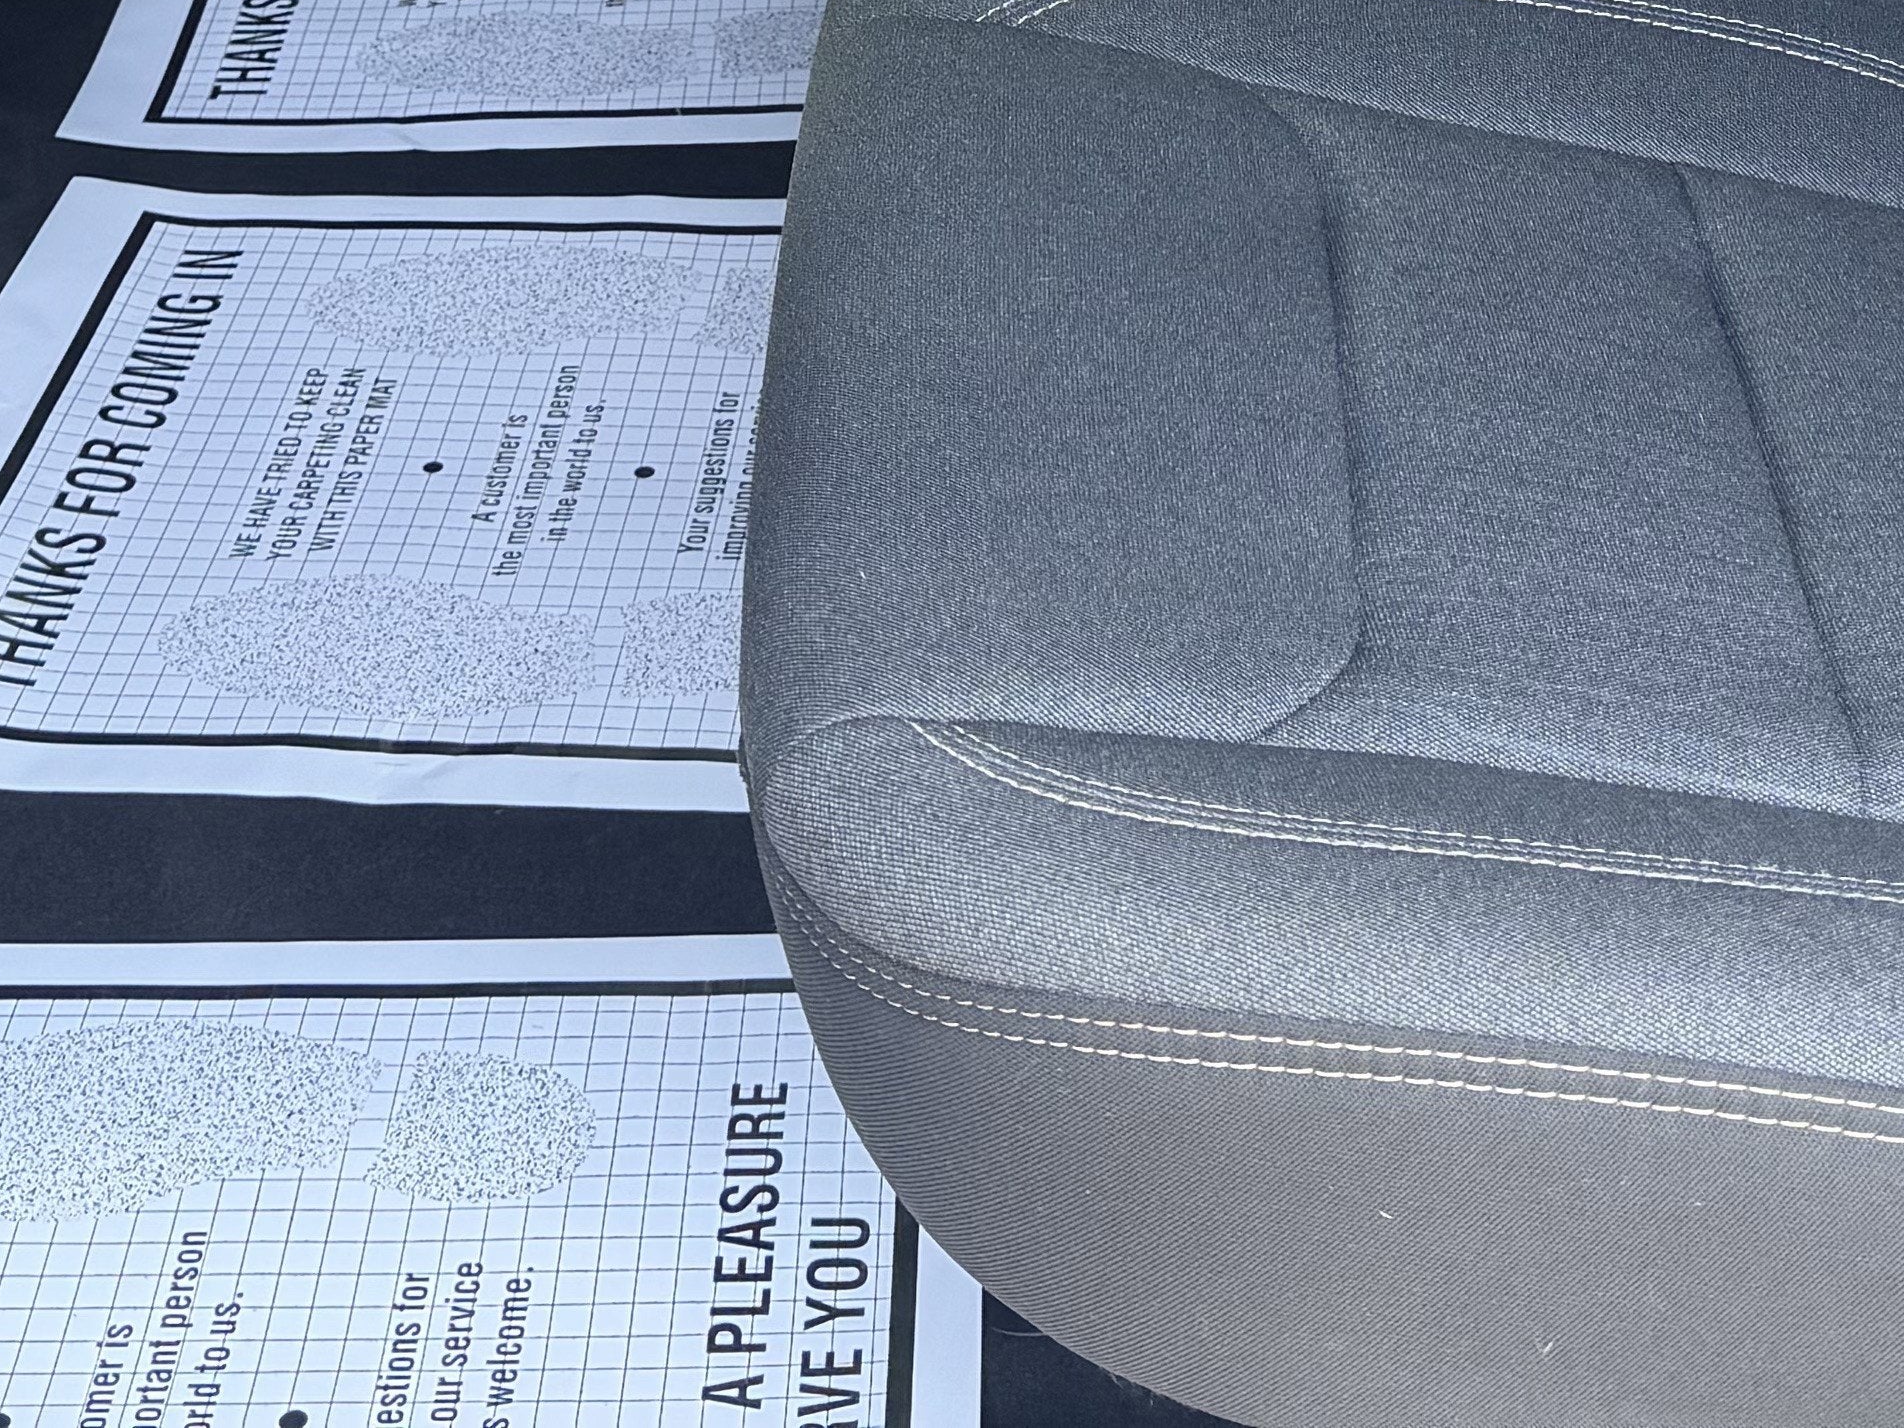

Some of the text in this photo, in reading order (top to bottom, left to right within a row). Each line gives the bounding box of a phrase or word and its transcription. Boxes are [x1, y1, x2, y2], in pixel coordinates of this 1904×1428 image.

[173, 249, 244, 280] IN
[99, 292, 224, 429] COMING
[53, 438, 151, 517] FOR
[229, 368, 329, 558] WE HAVE TRIED TO KEEP
[265, 368, 367, 561] YOUR CARPETING CLEAN
[307, 376, 398, 552] WITH THIS PAPER MAT
[471, 414, 528, 523] A customer is
[491, 365, 580, 576] the most important person
[540, 399, 607, 542] in the world to us.
[677, 392, 740, 554] Your suggestions for
[210, 1292, 244, 1334] us.
[702, 1082, 788, 1409] A PLEASURE
[804, 1217, 871, 1331] YOU
[80, 1323, 133, 1428] omer is
[132, 1231, 208, 1428] ortant person
[194, 1346, 231, 1373] to
[376, 1272, 430, 1428] estions for
[430, 1262, 483, 1422] our service
[486, 1266, 534, 1407] welcome.
